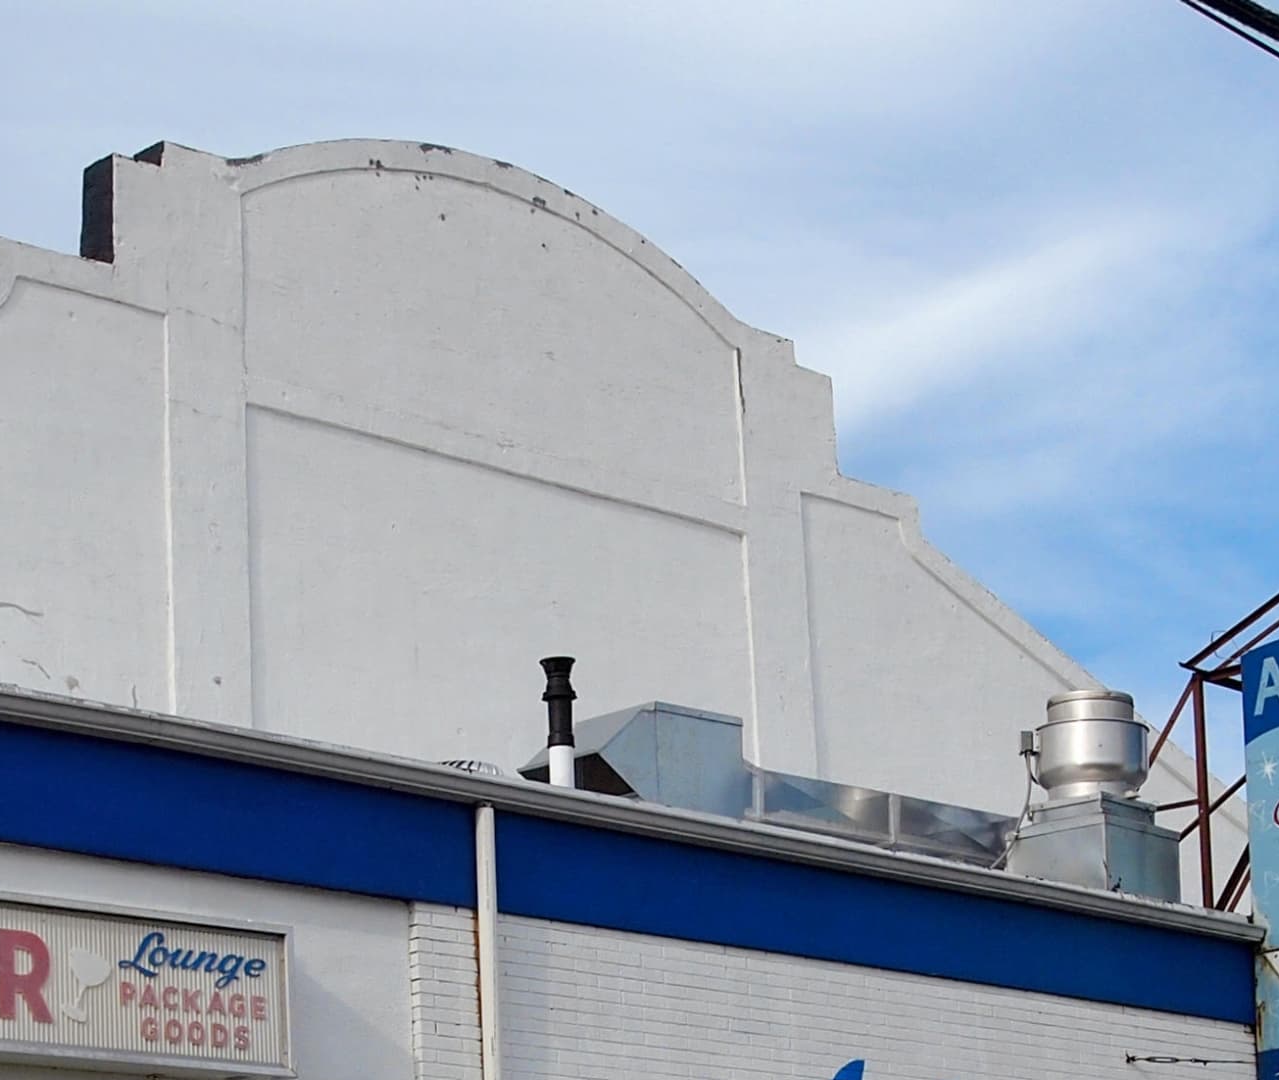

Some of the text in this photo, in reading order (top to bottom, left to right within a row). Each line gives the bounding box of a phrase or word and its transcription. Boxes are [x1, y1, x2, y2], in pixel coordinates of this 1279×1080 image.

[118, 931, 267, 989] Lounge
[120, 981, 268, 1020] PACKAGE
[140, 1017, 250, 1050] GOODS
